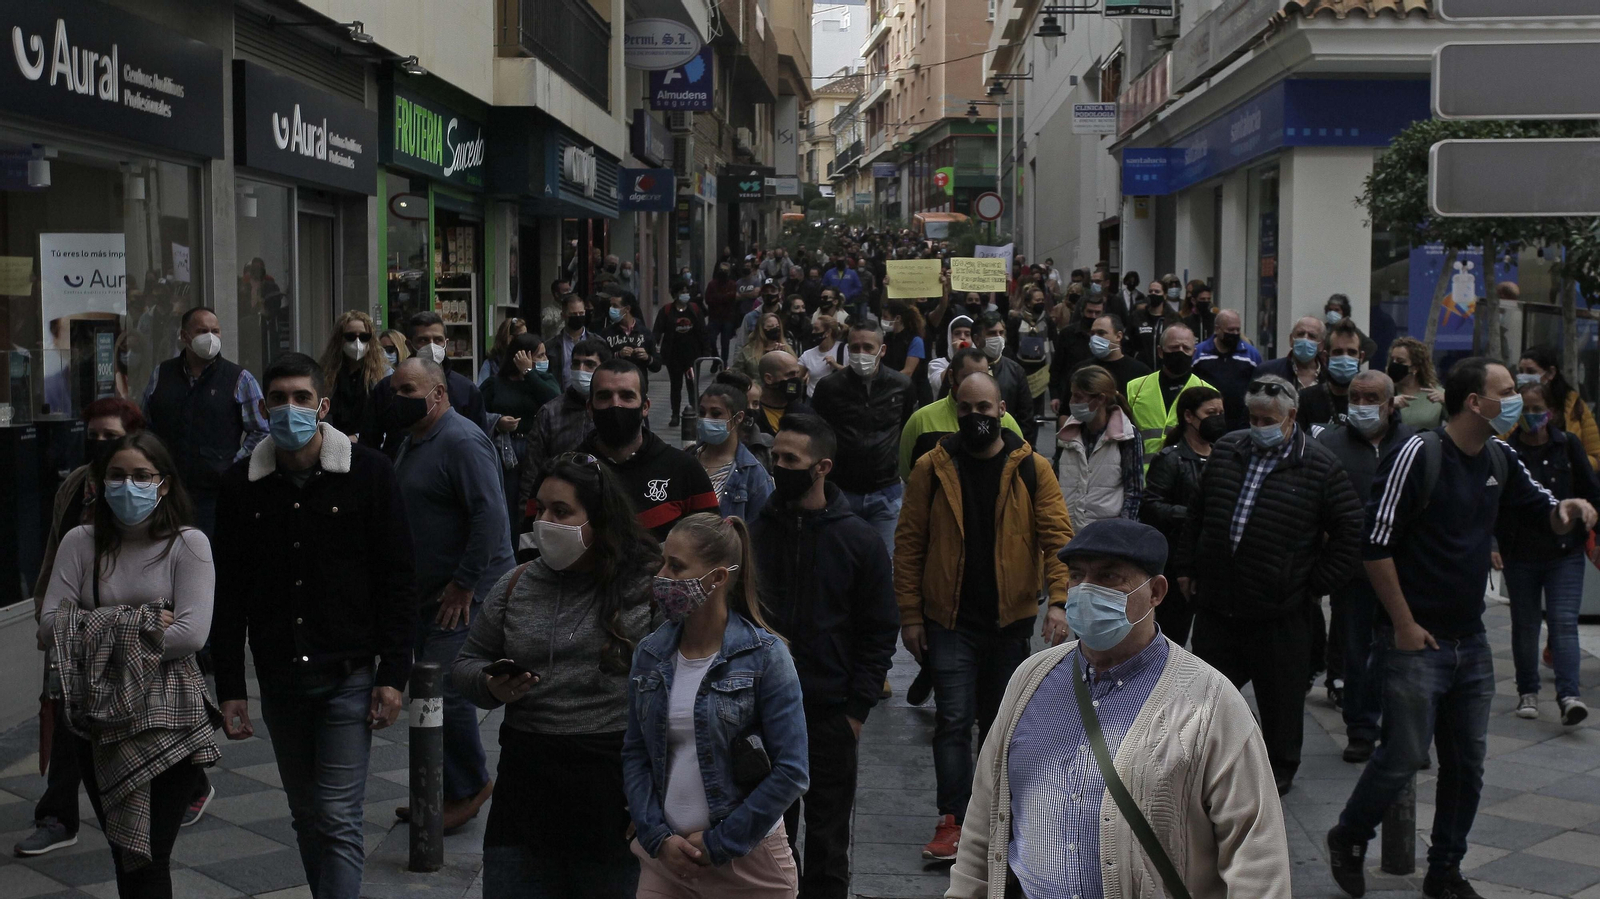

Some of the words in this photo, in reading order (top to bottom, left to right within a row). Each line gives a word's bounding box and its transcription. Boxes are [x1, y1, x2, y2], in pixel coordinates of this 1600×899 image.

[49, 18, 119, 103] Aural
[124, 88, 172, 118] Profesionales
[656, 90, 707, 99] Almudena
[290, 103, 327, 161] Aural
[394, 94, 443, 166] FRUTERIA
[443, 117, 485, 178] Saucedo
[51, 248, 61, 257] Tú
[81, 250, 89, 258] lo
[90, 250, 107, 258] más
